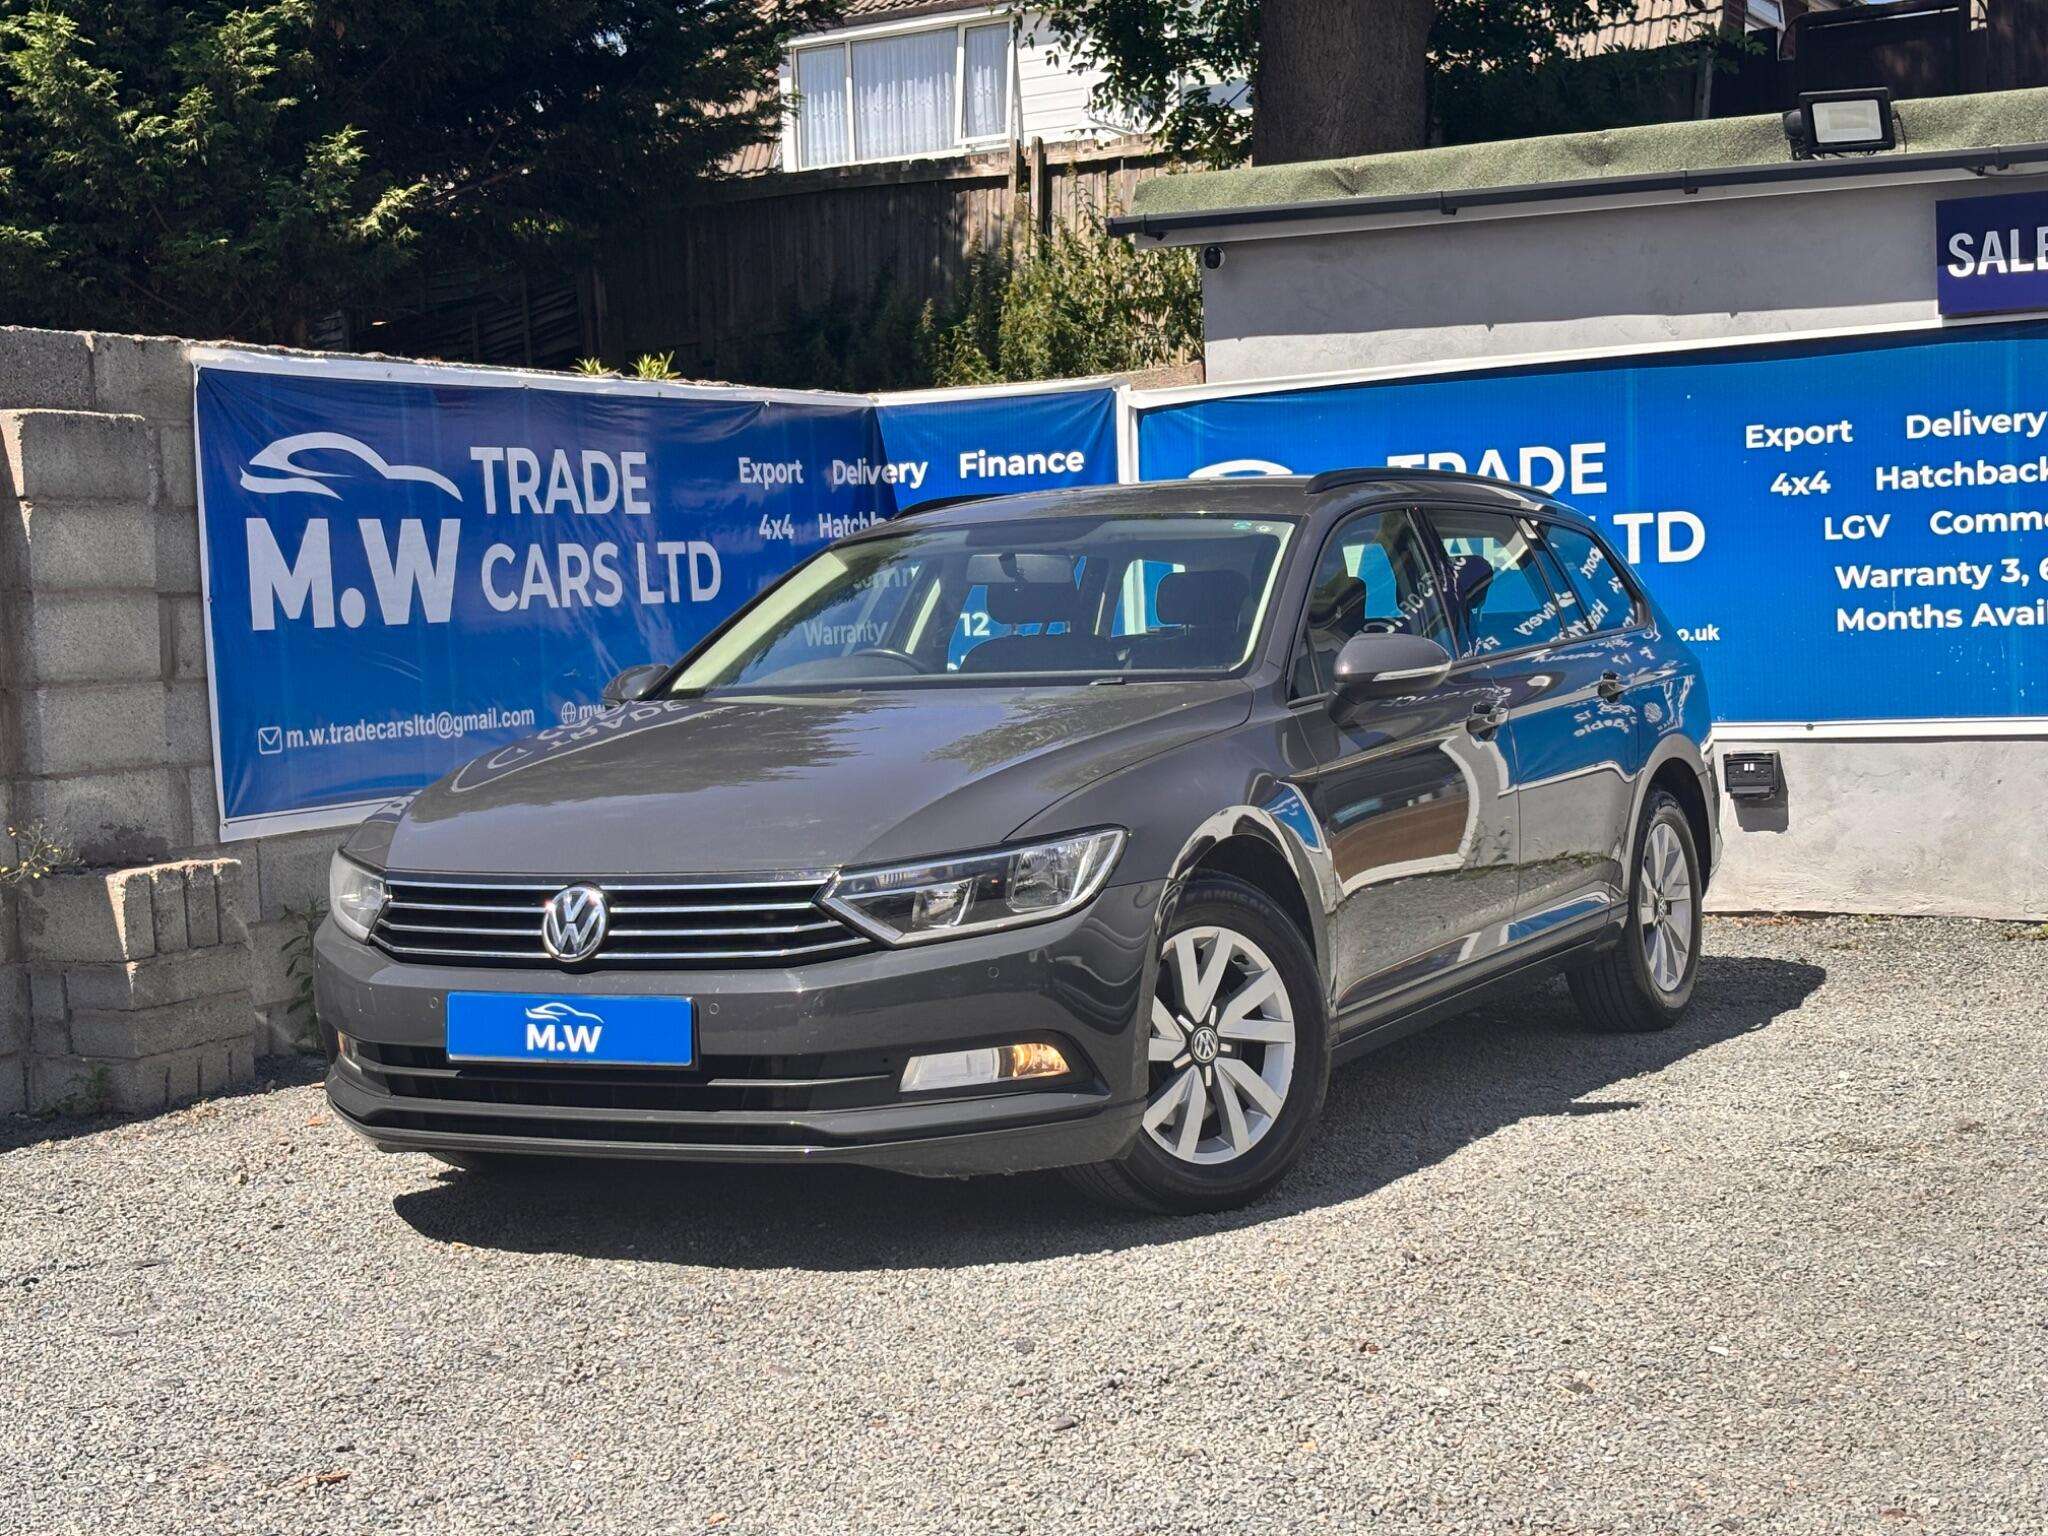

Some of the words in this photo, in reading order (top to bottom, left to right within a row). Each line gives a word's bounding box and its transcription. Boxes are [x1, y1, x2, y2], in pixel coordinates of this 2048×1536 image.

[1744, 419, 1854, 453] Export
[1906, 408, 2048, 439] Delivery
[470, 446, 650, 515] TRADE
[738, 456, 803, 490] Export
[832, 457, 928, 490] Delivery
[959, 449, 1086, 480] Finance
[1387, 442, 1607, 495] ADE
[1770, 471, 1831, 497] 4x4
[759, 514, 795, 541] 4x4
[1586, 511, 1706, 564] TD
[1824, 513, 1891, 541] LGV
[1929, 510, 2048, 536] Comm
[245, 518, 462, 632] M.W
[481, 542, 624, 612] CARS
[636, 541, 722, 605] LTD
[1834, 561, 1993, 591] Warranty
[2000, 558, 2030, 588] 3,
[803, 620, 888, 646] Warranty
[960, 612, 990, 637] 12
[1837, 603, 1963, 633] Months
[1971, 598, 2048, 628] Avai
[286, 706, 535, 749] m.w.tradecarsltd@gmail.com
[526, 1023, 604, 1053] M.W
